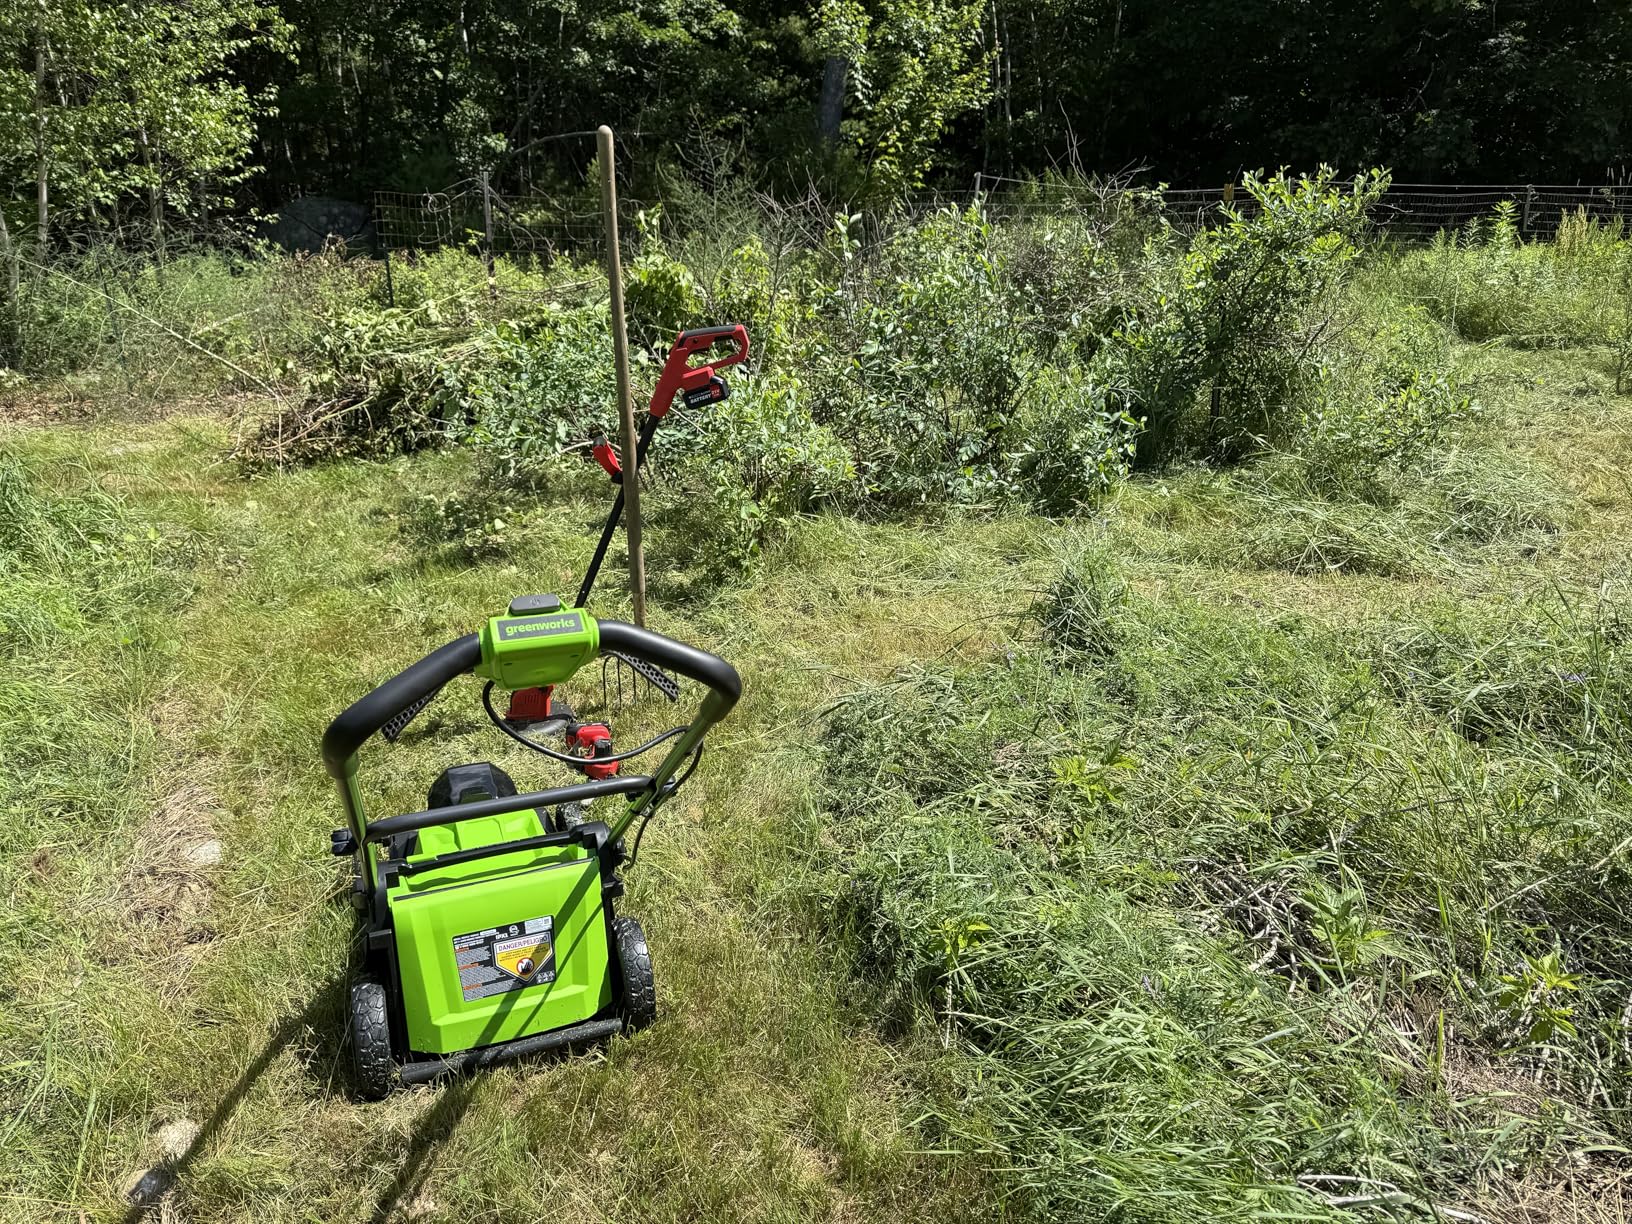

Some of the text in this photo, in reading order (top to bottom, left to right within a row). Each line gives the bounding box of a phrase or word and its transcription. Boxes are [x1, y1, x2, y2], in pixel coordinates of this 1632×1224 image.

[690, 393, 711, 404] BATTERY
[505, 618, 575, 636] greenworks
[498, 935, 548, 951] DANGER/PELIGRO
